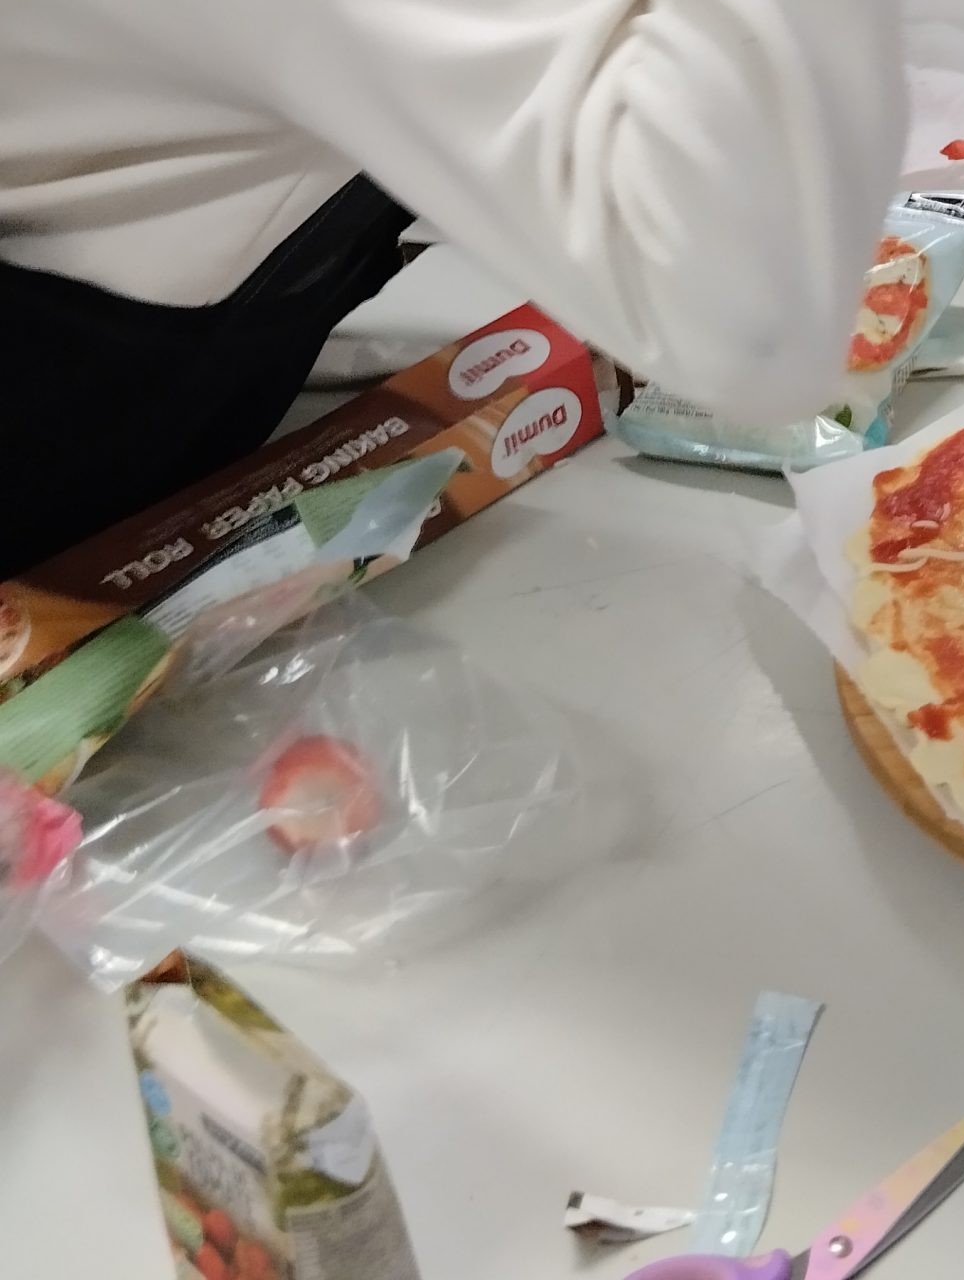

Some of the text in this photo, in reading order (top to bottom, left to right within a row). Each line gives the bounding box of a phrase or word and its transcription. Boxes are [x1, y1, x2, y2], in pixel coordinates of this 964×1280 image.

[460, 339, 531, 387] Dumil
[301, 416, 410, 484] BAKING
[502, 403, 568, 457] Dumil
[201, 476, 303, 540] PAPER
[99, 537, 194, 590] ROLL
